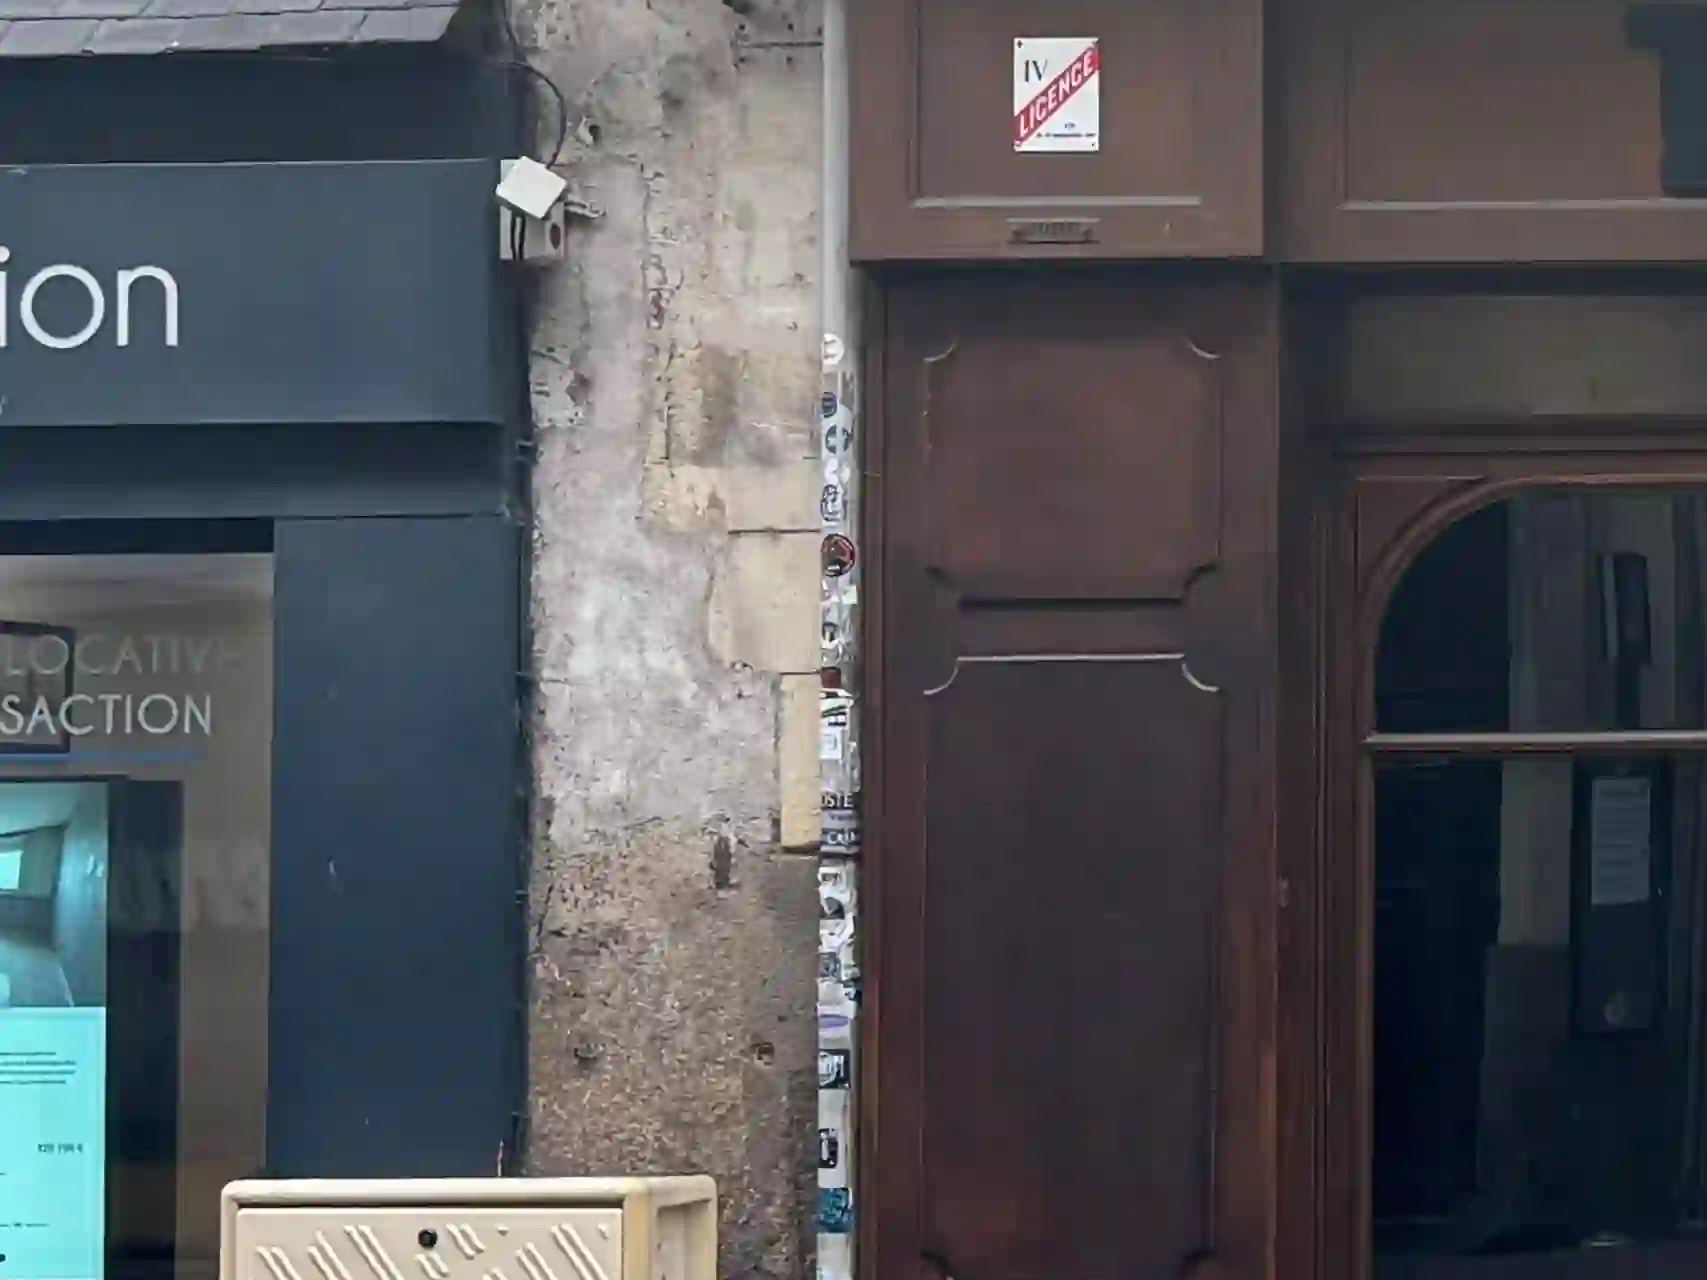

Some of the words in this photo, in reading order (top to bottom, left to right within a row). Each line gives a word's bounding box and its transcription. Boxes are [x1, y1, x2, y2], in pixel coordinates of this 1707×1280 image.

[1023, 58, 1048, 83] IV
[1019, 49, 1095, 139] LICENCE
[0, 693, 213, 736] SACTION
